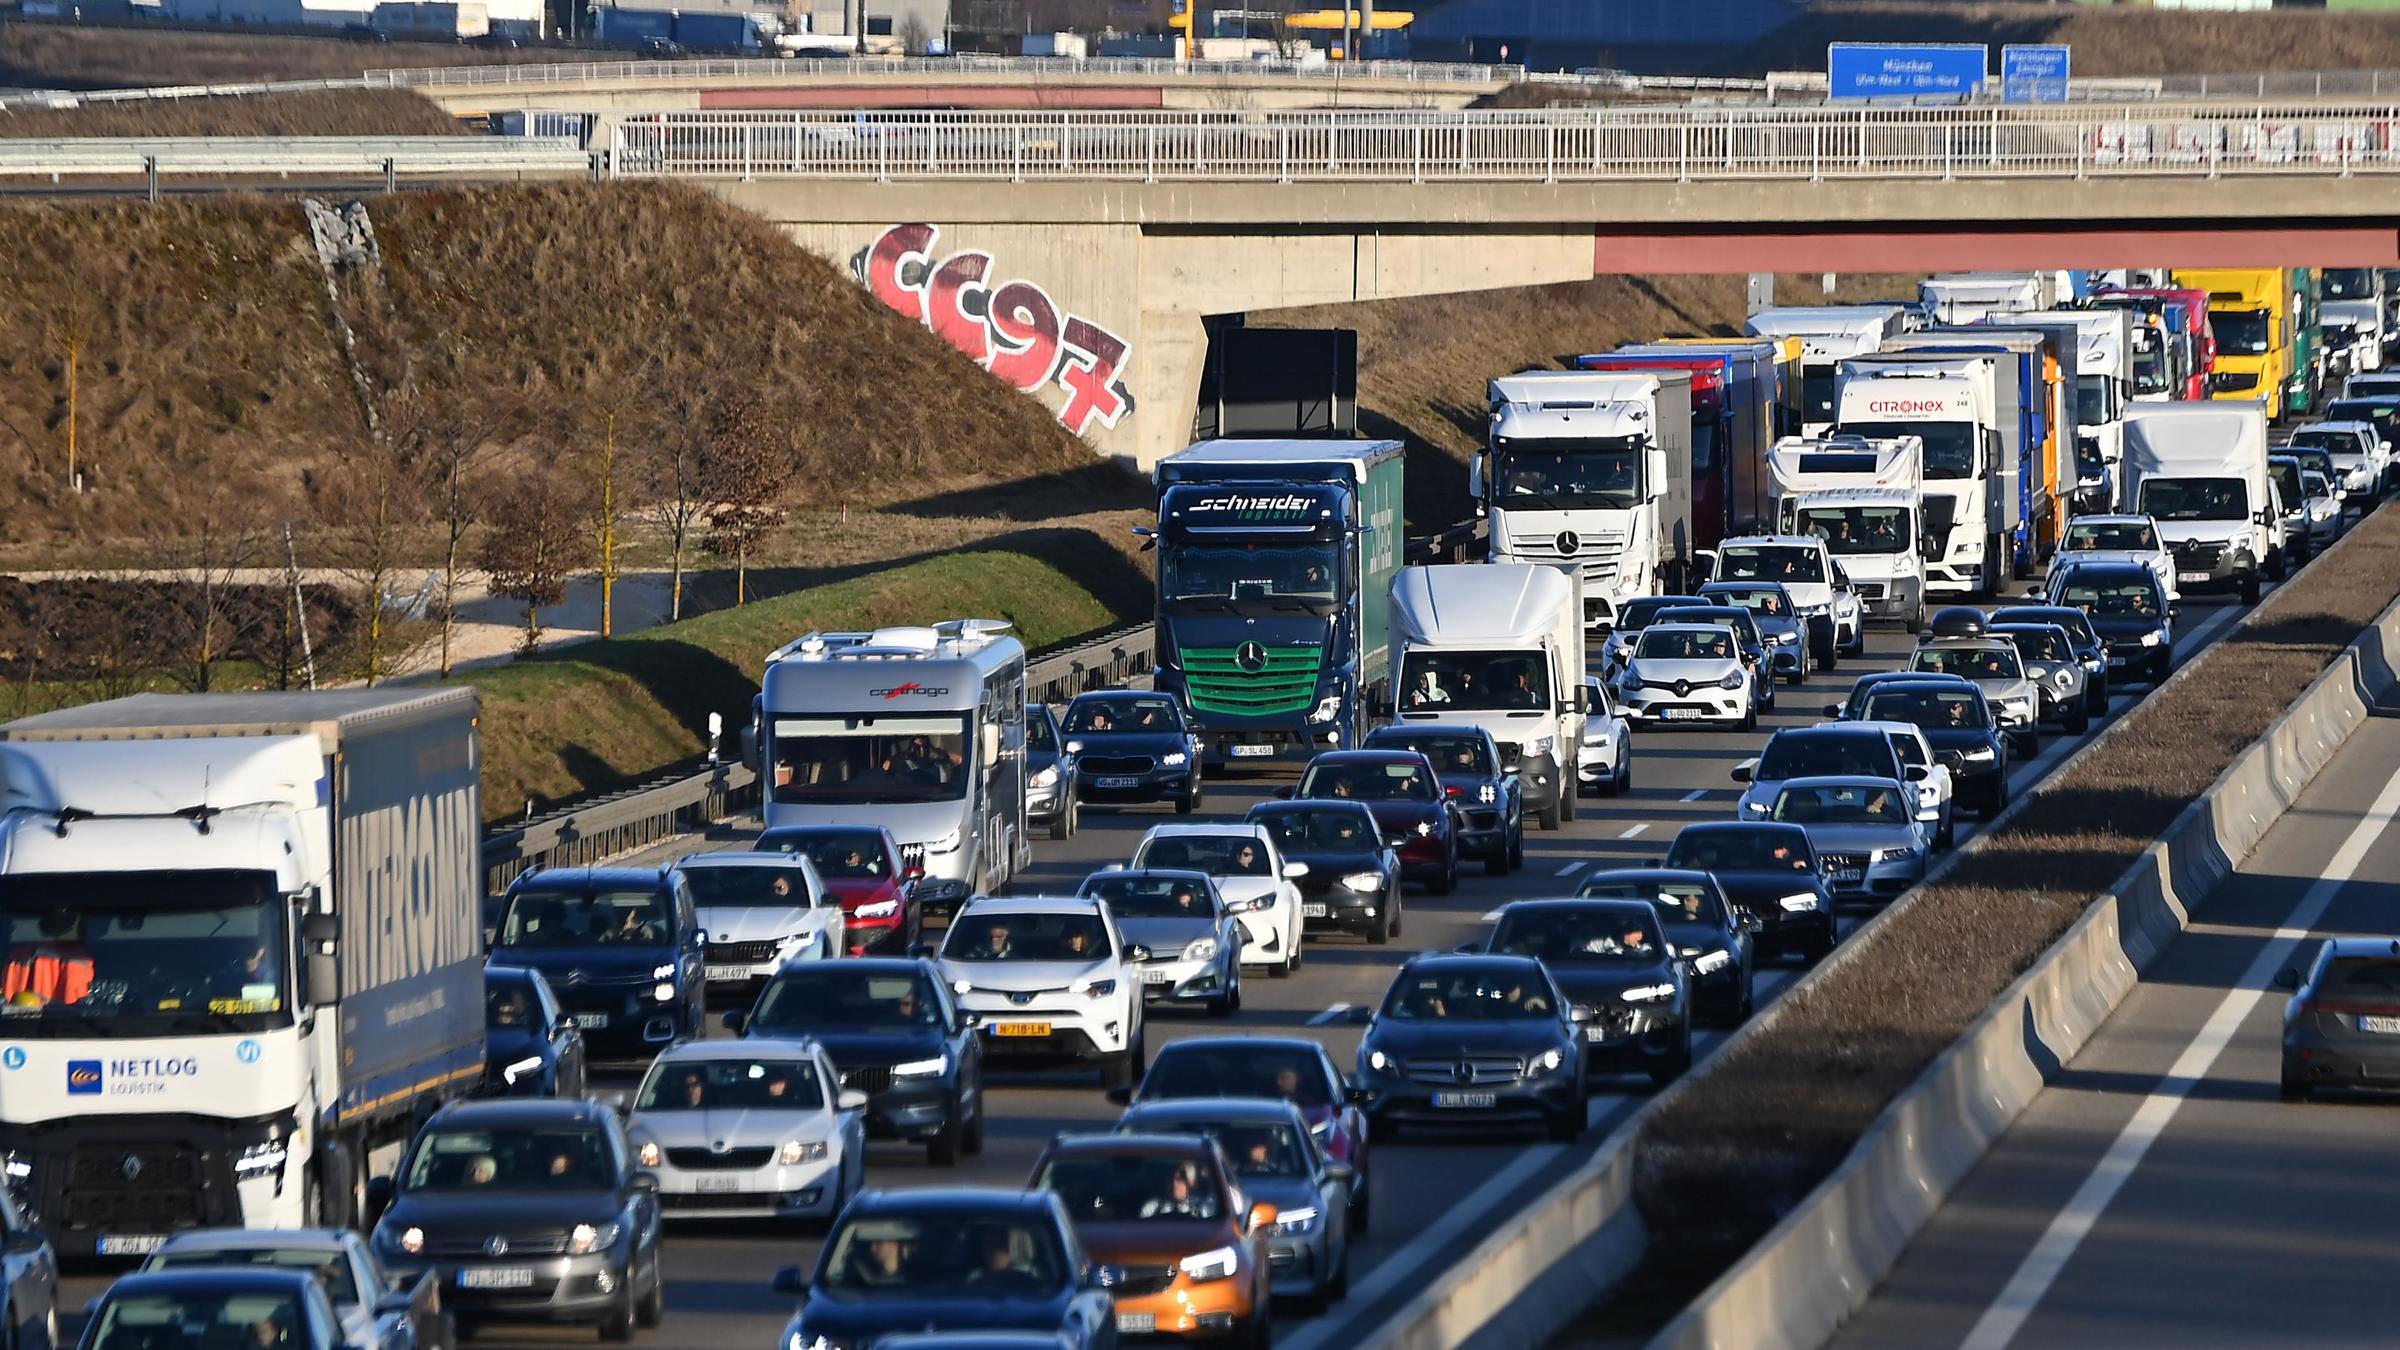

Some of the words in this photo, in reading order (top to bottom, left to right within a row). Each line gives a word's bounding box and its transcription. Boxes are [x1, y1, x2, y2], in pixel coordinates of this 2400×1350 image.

[866, 222, 1132, 437] CC97
[1188, 494, 1317, 511] schneider
[869, 681, 949, 699] carthago
[342, 785, 479, 1000] INTERCOMBI
[110, 1057, 198, 1077] NETLOG
